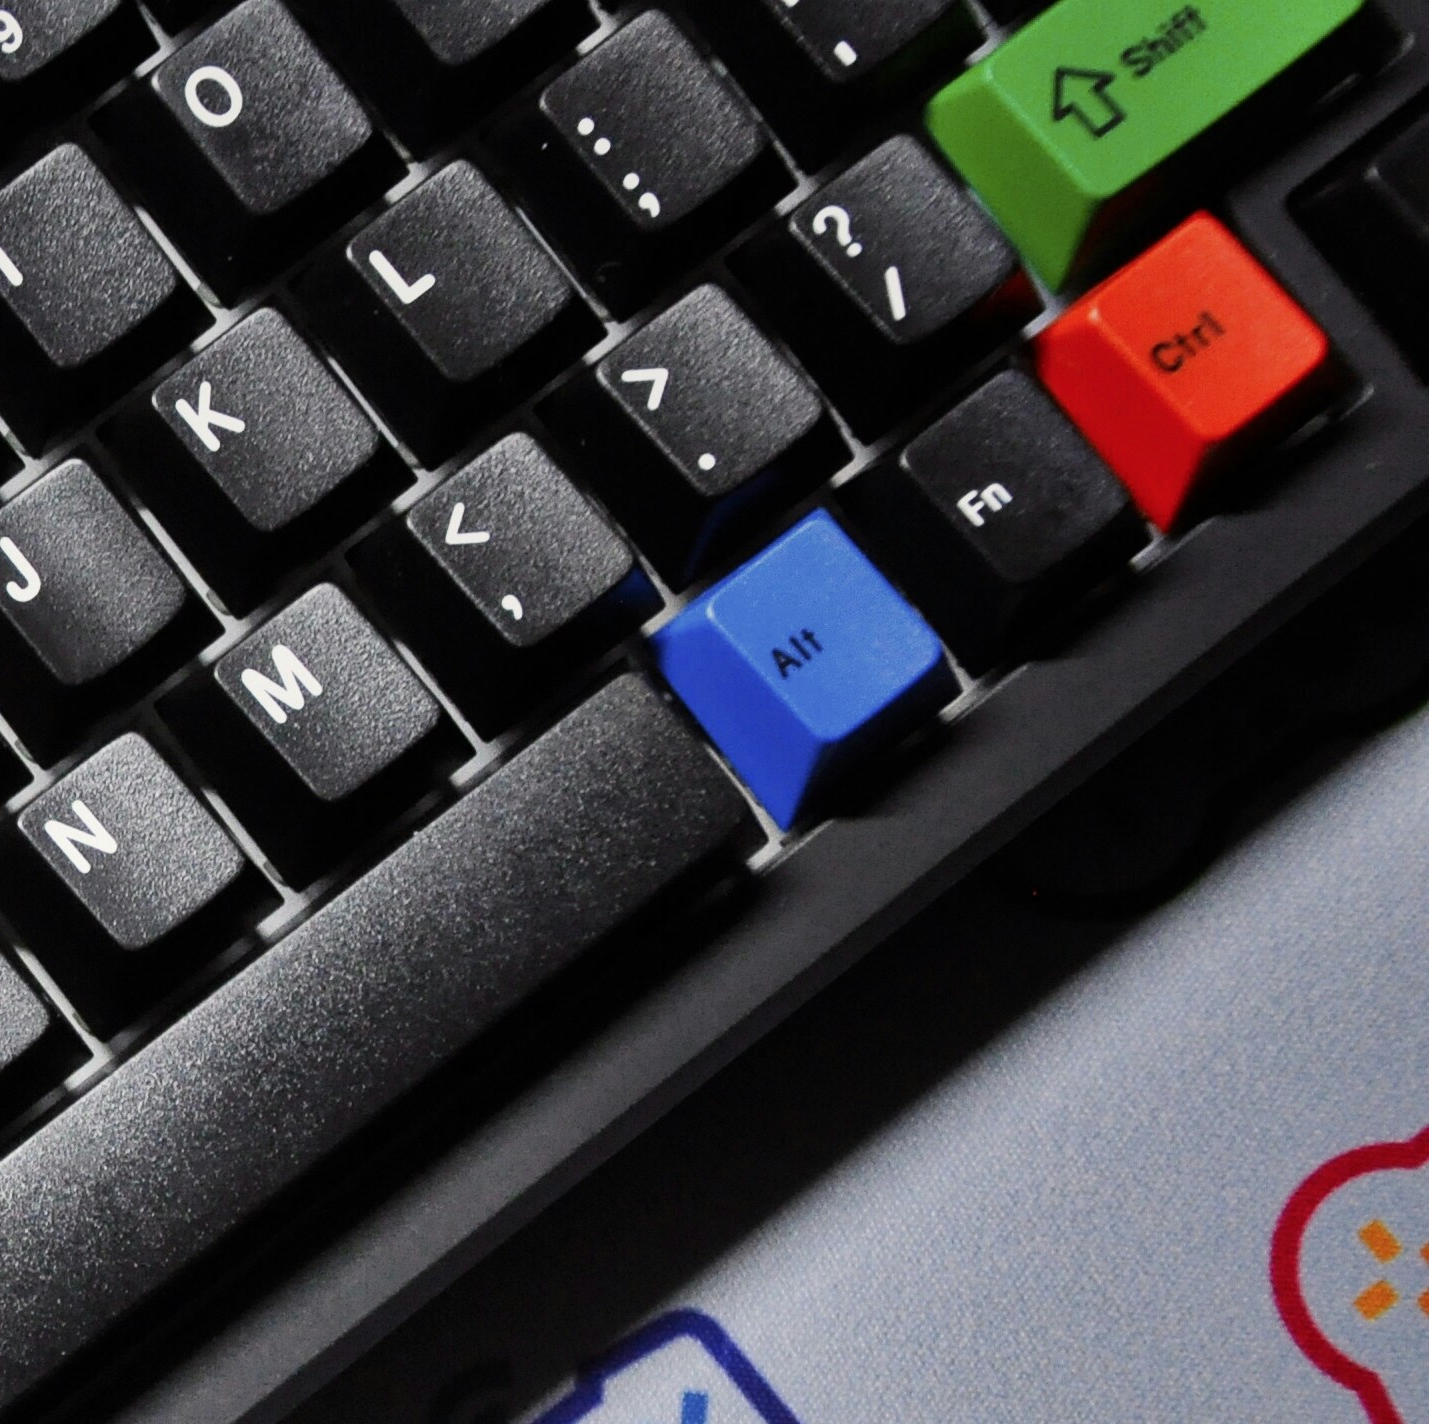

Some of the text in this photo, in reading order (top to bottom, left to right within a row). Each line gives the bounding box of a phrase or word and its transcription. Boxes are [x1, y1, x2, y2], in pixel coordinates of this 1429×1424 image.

[1118, 3, 1211, 80] Shift
[184, 65, 243, 128] O
[577, 117, 611, 155] :
[623, 172, 660, 217] ;
[813, 205, 862, 257] ?
[368, 250, 436, 304] L
[885, 266, 906, 320] /
[1148, 311, 1224, 375] Ctrl
[175, 380, 246, 452] K
[621, 367, 669, 411] >
[444, 502, 491, 545] <
[958, 483, 1012, 526] Fn
[0, 536, 42, 603] J
[501, 594, 523, 620] ,
[770, 628, 823, 680] Alt
[240, 643, 324, 724] M
[43, 798, 119, 875] N
